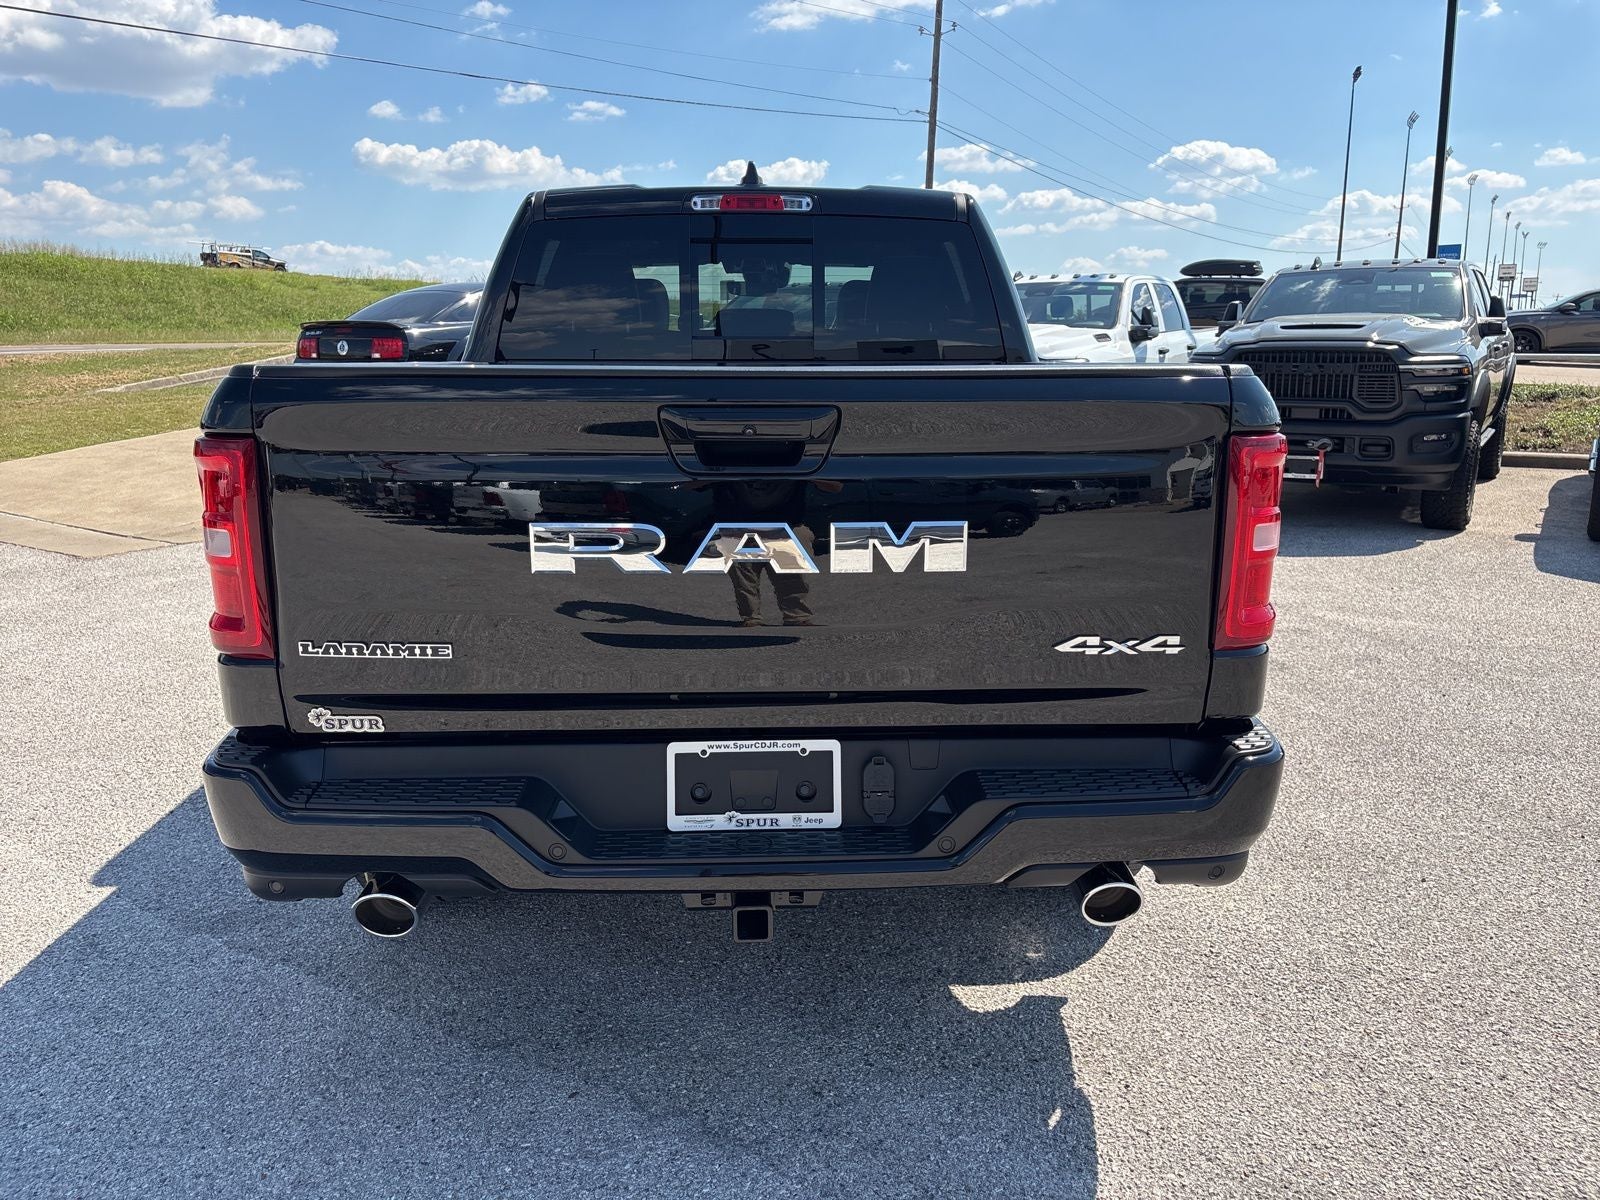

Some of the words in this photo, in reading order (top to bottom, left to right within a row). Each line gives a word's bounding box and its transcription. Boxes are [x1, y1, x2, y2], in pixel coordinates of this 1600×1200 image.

[529, 521, 968, 574] RAM
[298, 641, 452, 659] LARAMIE
[1054, 635, 1185, 655] 4x4
[324, 718, 382, 730] SPUR
[707, 741, 801, 750] www.SpurCDJR.com
[735, 818, 780, 827] SPUR
[804, 817, 823, 825] Jeep
